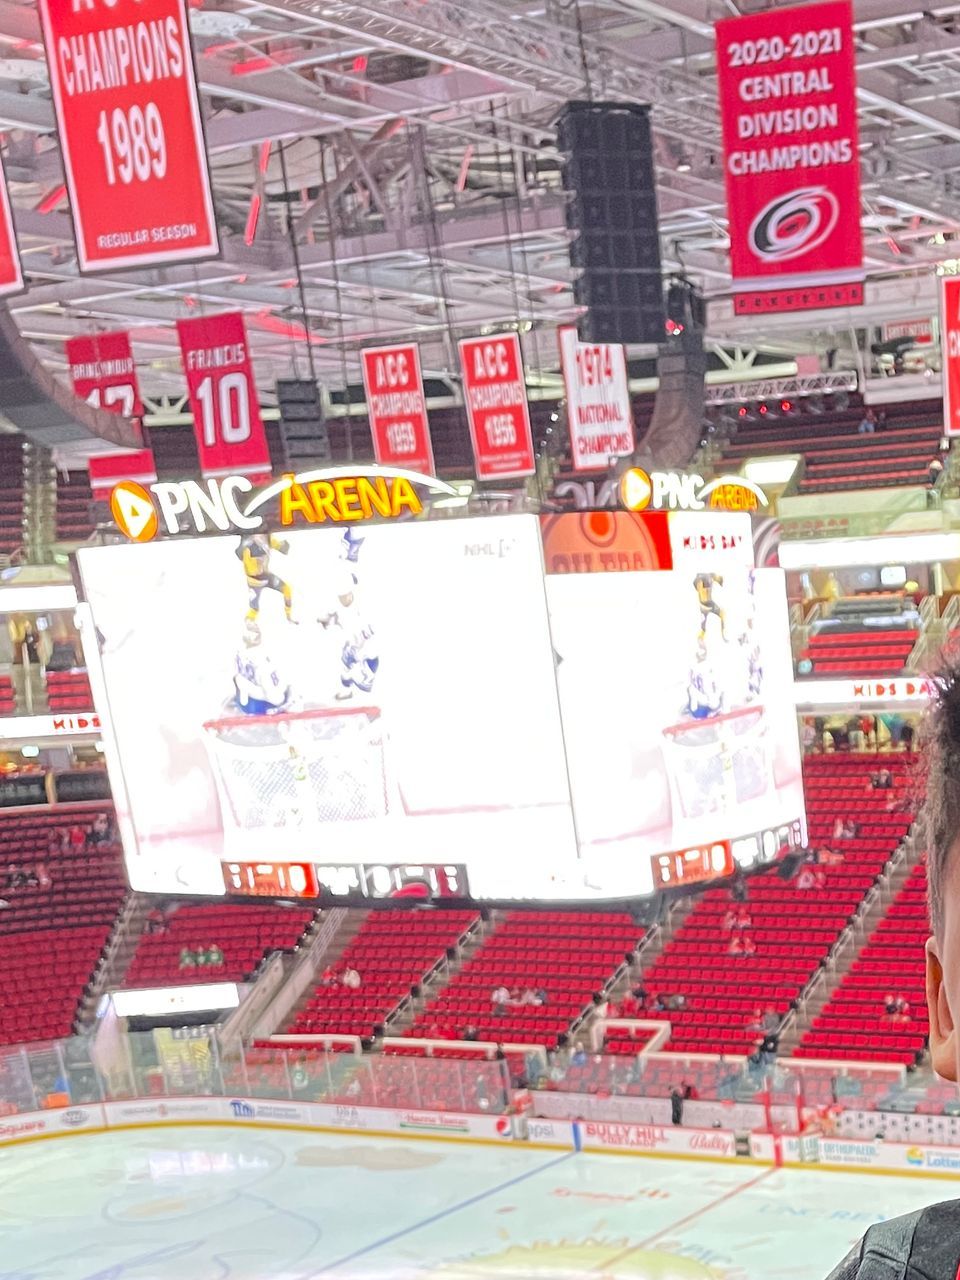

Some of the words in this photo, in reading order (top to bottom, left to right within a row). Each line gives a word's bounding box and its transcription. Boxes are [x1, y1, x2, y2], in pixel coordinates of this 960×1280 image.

[59, 16, 184, 96] CHAMPIONS
[728, 28, 842, 67] 2020-2021
[739, 68, 833, 102] CENTRAL
[738, 104, 838, 139] DIVISION
[97, 102, 167, 186] 1989
[728, 139, 853, 175] CHAMPIONS
[97, 227, 150, 249] REGULAR
[151, 223, 197, 243] SEASON
[187, 342, 246, 370] FRANCIS
[375, 353, 409, 388] ACC
[473, 343, 510, 380] ACC
[196, 372, 251, 446] 10
[578, 403, 624, 425] NATIONAL
[151, 476, 263, 534] PNC
[280, 473, 424, 526] ARENA
[651, 472, 706, 510] PNC
[854, 683, 896, 697] KIDS
[586, 1123, 632, 1141] BULLY
[636, 1127, 667, 1141] HILL
